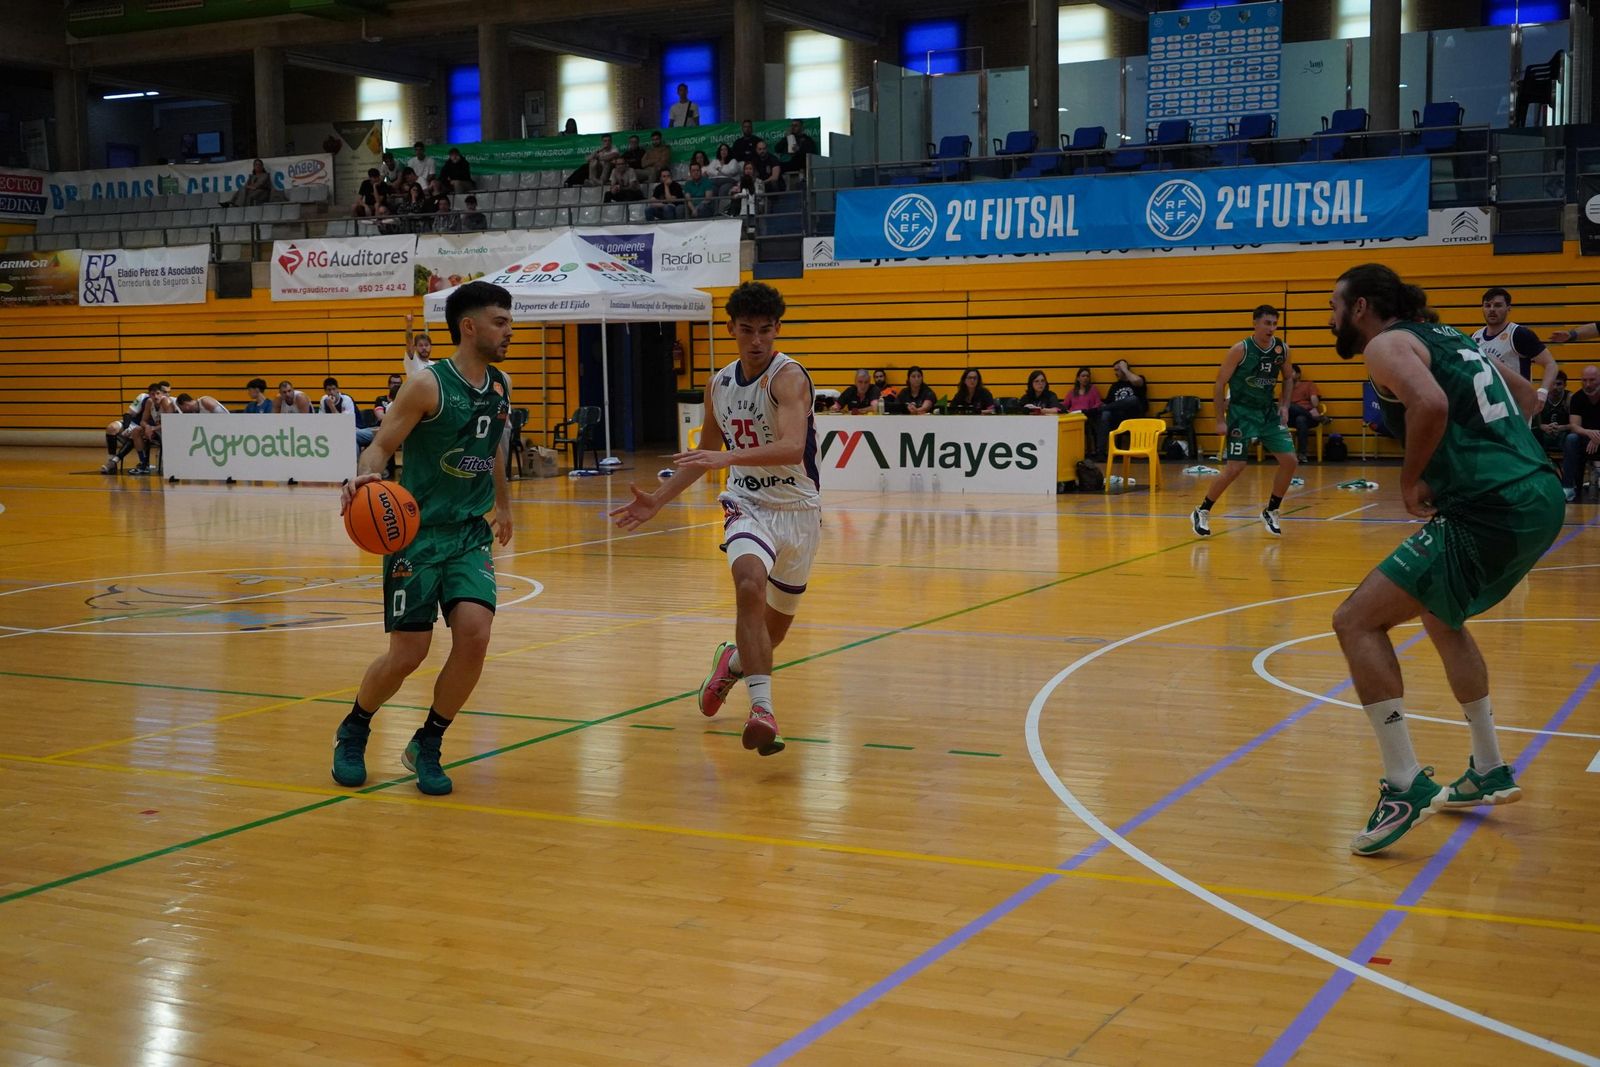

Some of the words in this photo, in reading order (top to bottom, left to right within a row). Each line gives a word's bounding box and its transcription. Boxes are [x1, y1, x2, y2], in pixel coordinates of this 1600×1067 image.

[1256, 178, 1369, 229] FUTSAL
[980, 194, 1079, 241] FUTSAL
[661, 252, 702, 265] Radio
[707, 251, 732, 264] luz
[118, 268, 138, 278] Eladio
[140, 268, 158, 277] Pérez
[160, 268, 166, 276] &
[168, 266, 203, 276] Asociados
[492, 275, 511, 284] EL
[516, 274, 567, 283] EJIDO
[162, 277, 189, 287] Seguros
[281, 286, 349, 295] www.rgauditores.eu
[358, 285, 372, 293] 950
[375, 284, 384, 292] 25
[397, 283, 406, 291] 42
[514, 302, 547, 312] Deportes
[549, 302, 559, 310] de
[560, 301, 569, 309] El
[570, 300, 590, 311] Ejido
[1260, 362, 1271, 373] 13
[475, 415, 492, 439] 0
[731, 419, 760, 449] 25
[189, 426, 330, 467] Agroatlas
[1230, 442, 1243, 455] 13
[899, 432, 1039, 478] Mayes
[457, 456, 494, 472] Fitos
[379, 492, 401, 541] Wilson
[393, 589, 407, 617] 0
